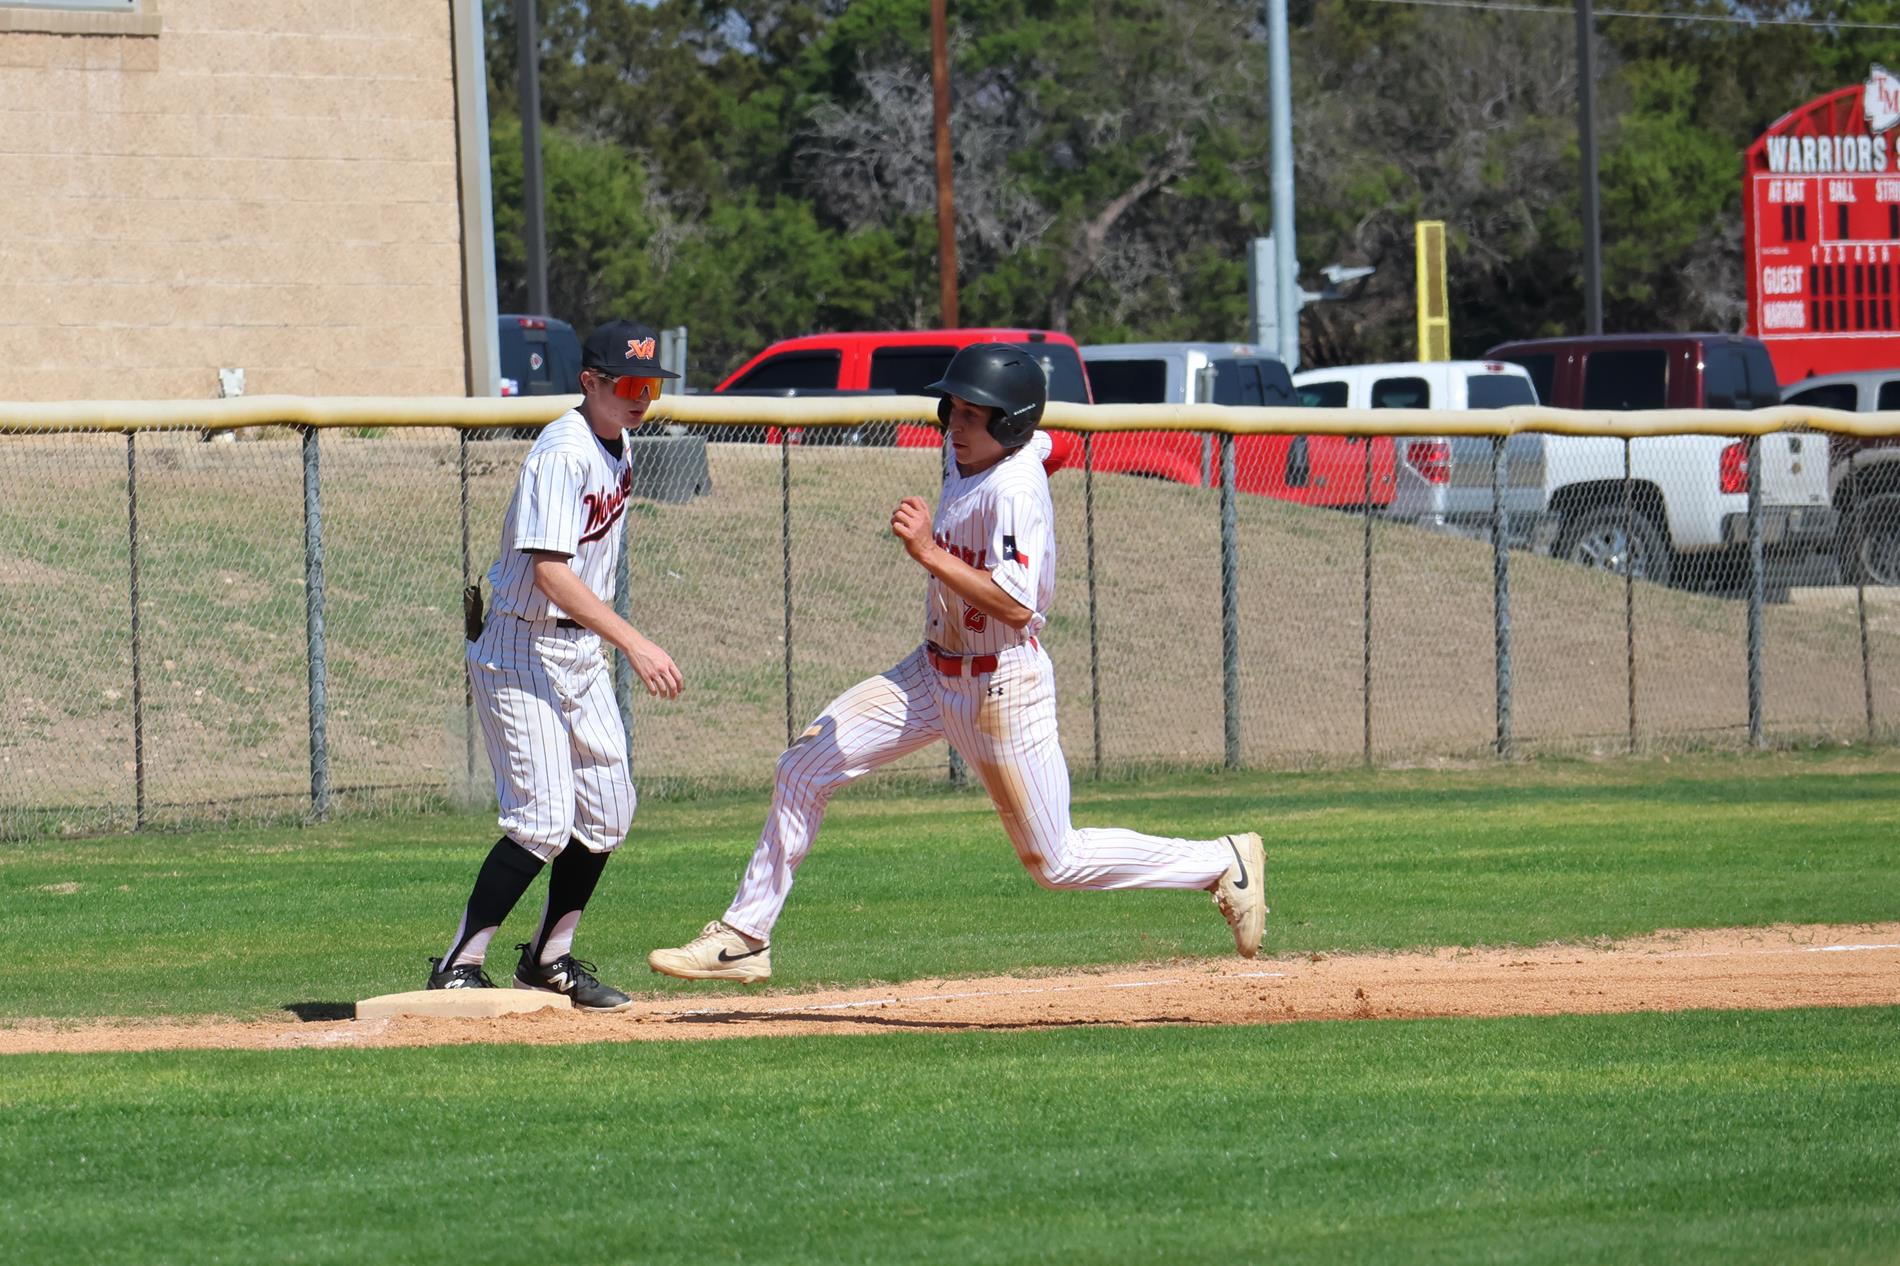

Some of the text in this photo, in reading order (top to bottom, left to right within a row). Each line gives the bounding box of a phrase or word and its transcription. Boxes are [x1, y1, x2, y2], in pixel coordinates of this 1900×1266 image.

[1766, 135, 1887, 173] WARRIORS
[1828, 180, 1857, 203] BALL
[1763, 265, 1803, 295] GUEST
